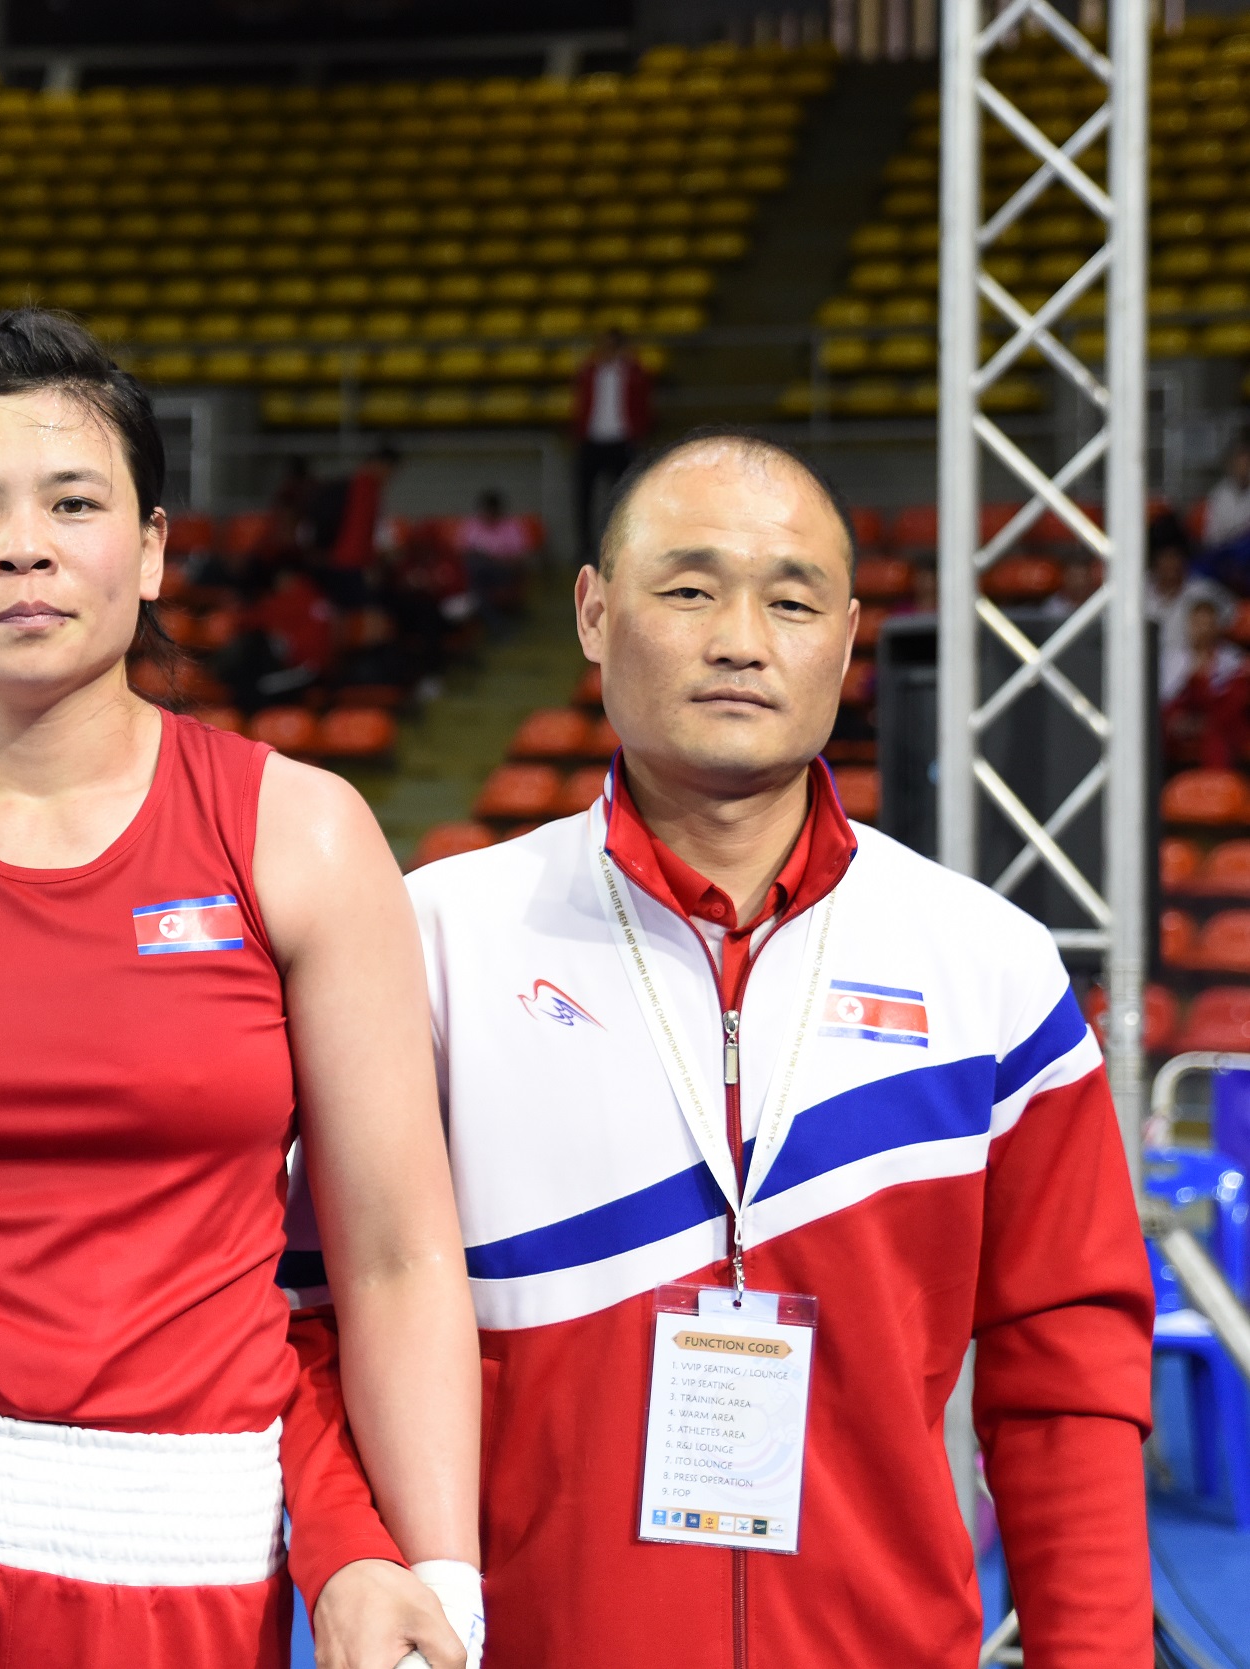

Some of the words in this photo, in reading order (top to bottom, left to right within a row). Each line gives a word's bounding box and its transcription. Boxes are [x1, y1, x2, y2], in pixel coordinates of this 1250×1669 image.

[814, 906, 833, 966] CHAMPIONSHIPS
[808, 966, 821, 996] BOXING
[603, 869, 616, 891] ASIAN
[610, 890, 623, 911] ELITE
[617, 909, 630, 928] MEN
[624, 928, 636, 946] AND
[630, 945, 648, 976] WOMEN
[642, 976, 661, 1008] BOXING
[655, 1008, 688, 1076] CHAMPIONSHIPS
[683, 1076, 705, 1118] BANGKOK
[701, 1119, 714, 1140] 2019
[799, 997, 813, 1029] WOMEN
[794, 1030, 804, 1049] AND
[789, 1050, 799, 1069] MEN
[781, 1069, 794, 1092] ELITE
[774, 1093, 788, 1119] ASIAN
[768, 1120, 780, 1143] ASBC
[684, 1336, 744, 1351] FUNCTION
[747, 1342, 780, 1355] CODE
[681, 1362, 701, 1371] VVIP
[703, 1364, 741, 1376] SEATING
[749, 1369, 789, 1380] LOUNGE
[670, 1377, 678, 1386] 2.
[681, 1378, 696, 1387] VIP
[697, 1379, 736, 1391] SEATING
[670, 1393, 677, 1401] 3.
[680, 1393, 725, 1406] TRAINING
[728, 1399, 751, 1408] AREA
[668, 1409, 676, 1417] 4.
[678, 1409, 709, 1420] WARM
[711, 1413, 735, 1422] AREA
[666, 1424, 674, 1433] 5.
[677, 1425, 720, 1437] ATHLETES
[722, 1430, 746, 1439] AREA
[665, 1440, 673, 1448] 6.
[676, 1441, 692, 1450] R&J
[695, 1443, 734, 1455] LOUNGE
[664, 1456, 672, 1465] 7.
[674, 1457, 691, 1466] ITO
[693, 1459, 733, 1470] LOUNGE
[663, 1472, 670, 1480] 8.
[673, 1473, 698, 1482] PRESS
[699, 1475, 753, 1488] OPERATION
[661, 1487, 670, 1496] 9.
[672, 1488, 691, 1497] FOP
